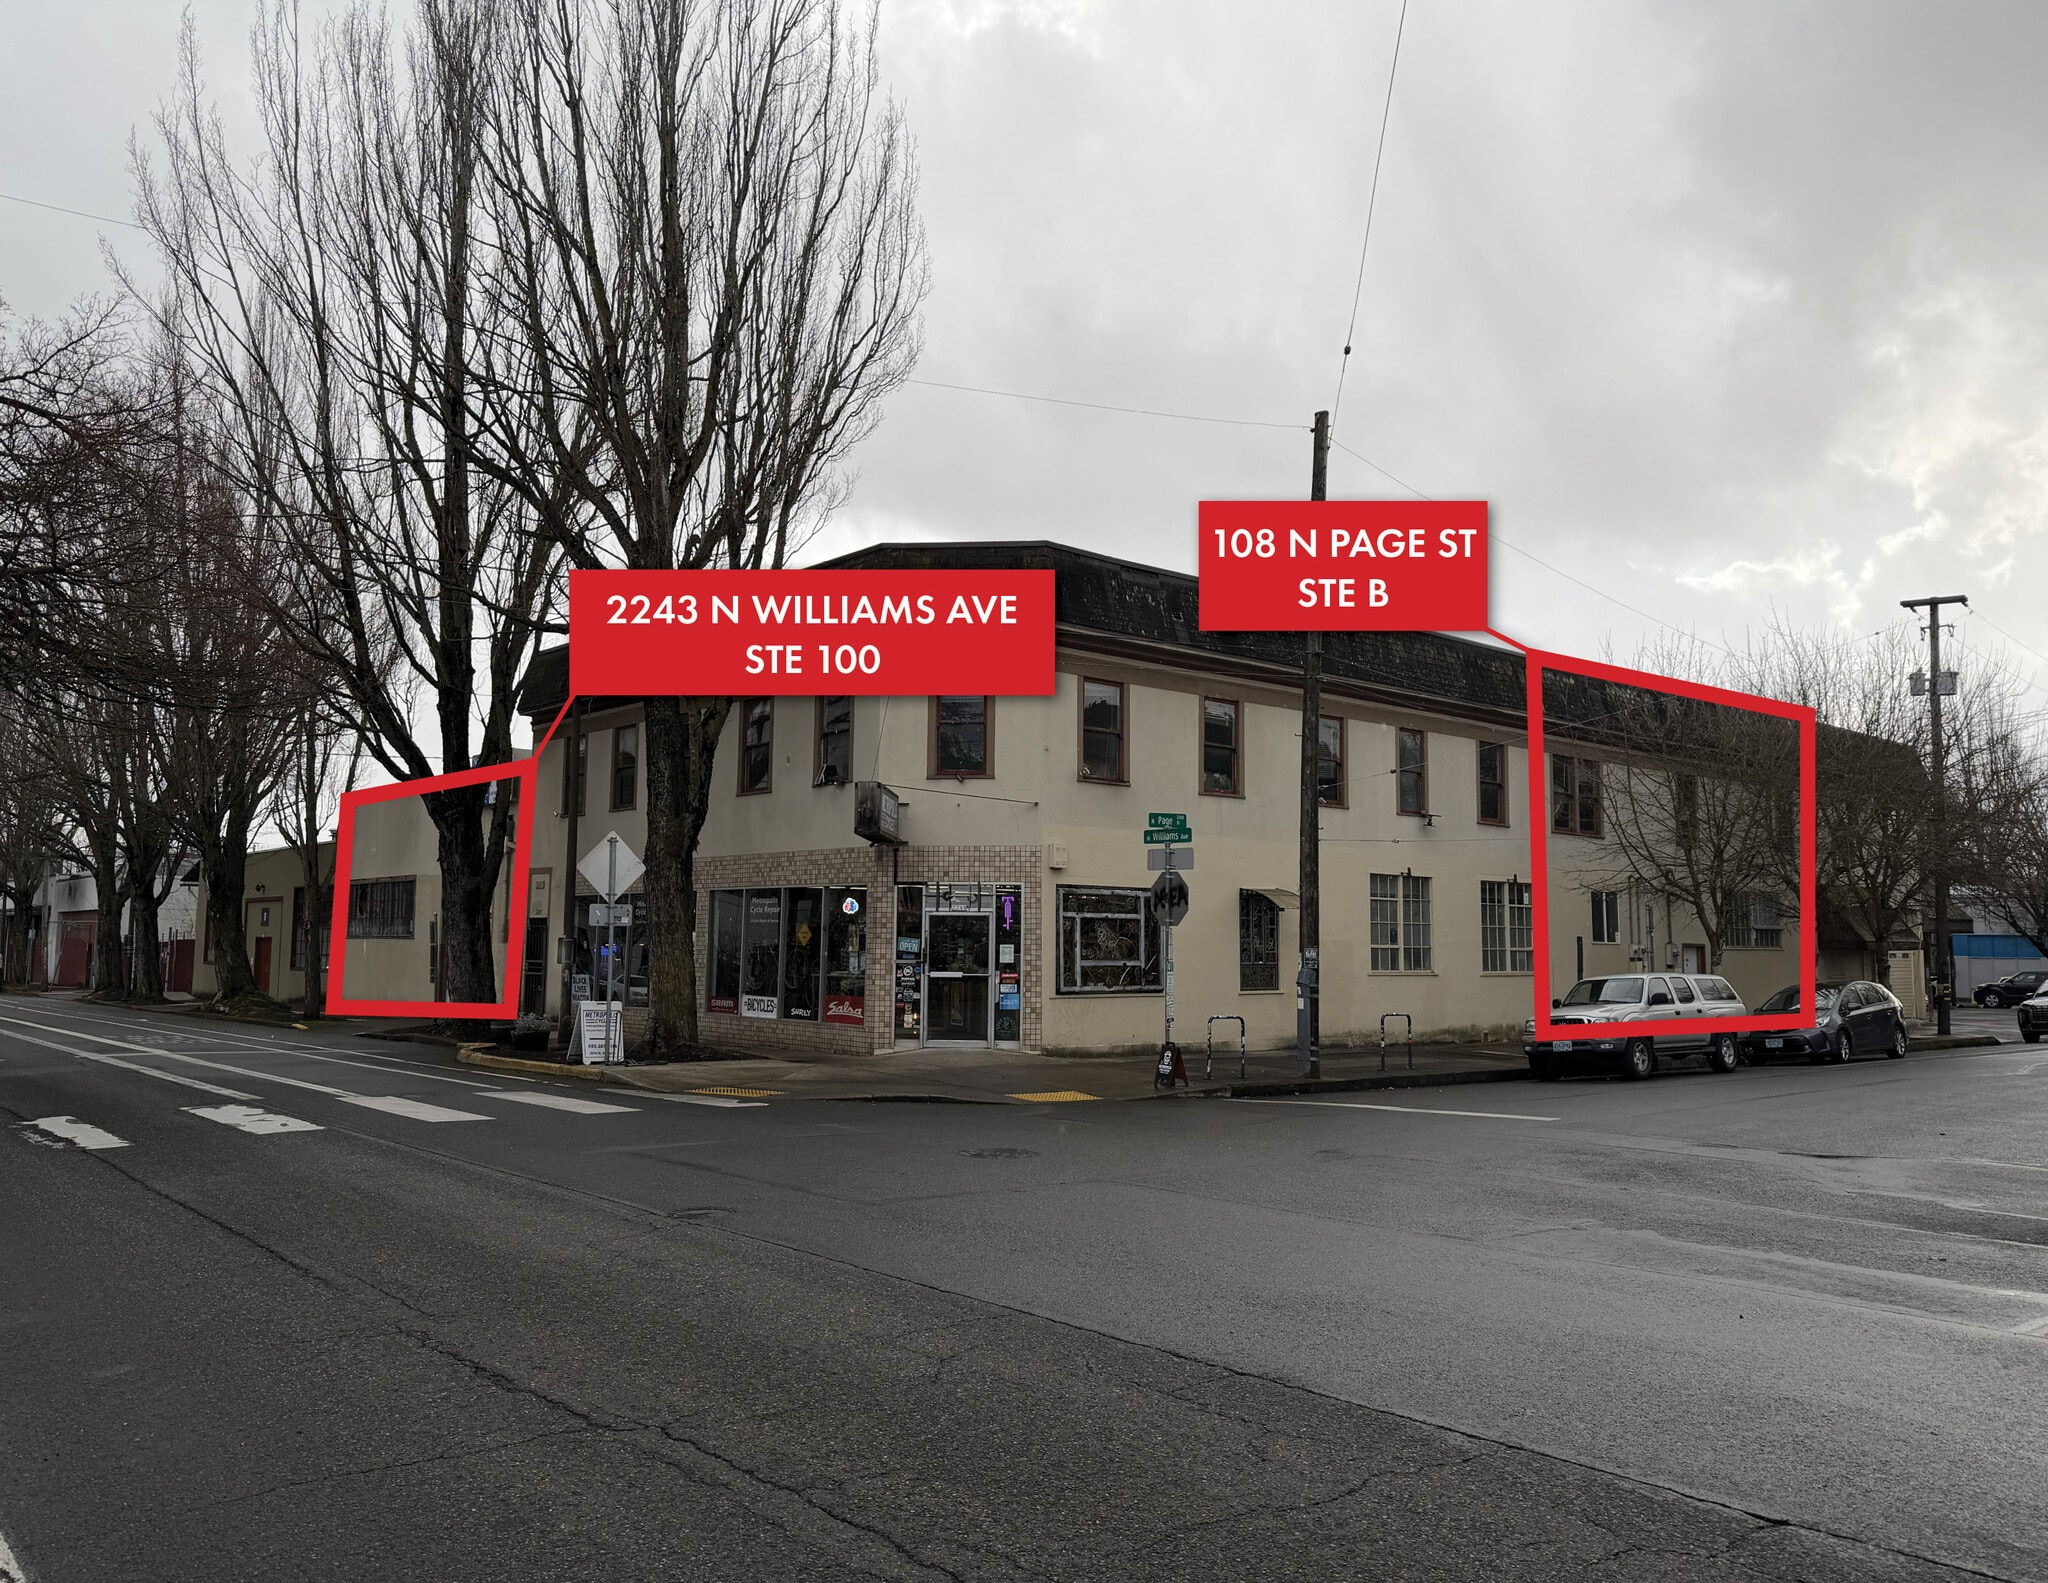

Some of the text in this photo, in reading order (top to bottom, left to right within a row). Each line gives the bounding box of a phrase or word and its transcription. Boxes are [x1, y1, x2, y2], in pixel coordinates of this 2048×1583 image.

[1158, 816, 1173, 828] Page
[1153, 832, 1179, 841] Williams
[752, 896, 778, 906] Metropolis
[750, 906, 781, 915] Cycle Repair
[899, 941, 918, 952] OPEN
[572, 976, 587, 984] BLACK
[574, 985, 587, 993] LIVES
[711, 1000, 734, 1008] SRAM
[747, 998, 775, 1013] BICYCLES
[790, 1008, 812, 1017] SURLY
[827, 1001, 863, 1018] Salsa
[585, 1011, 618, 1019] METROPLIS
